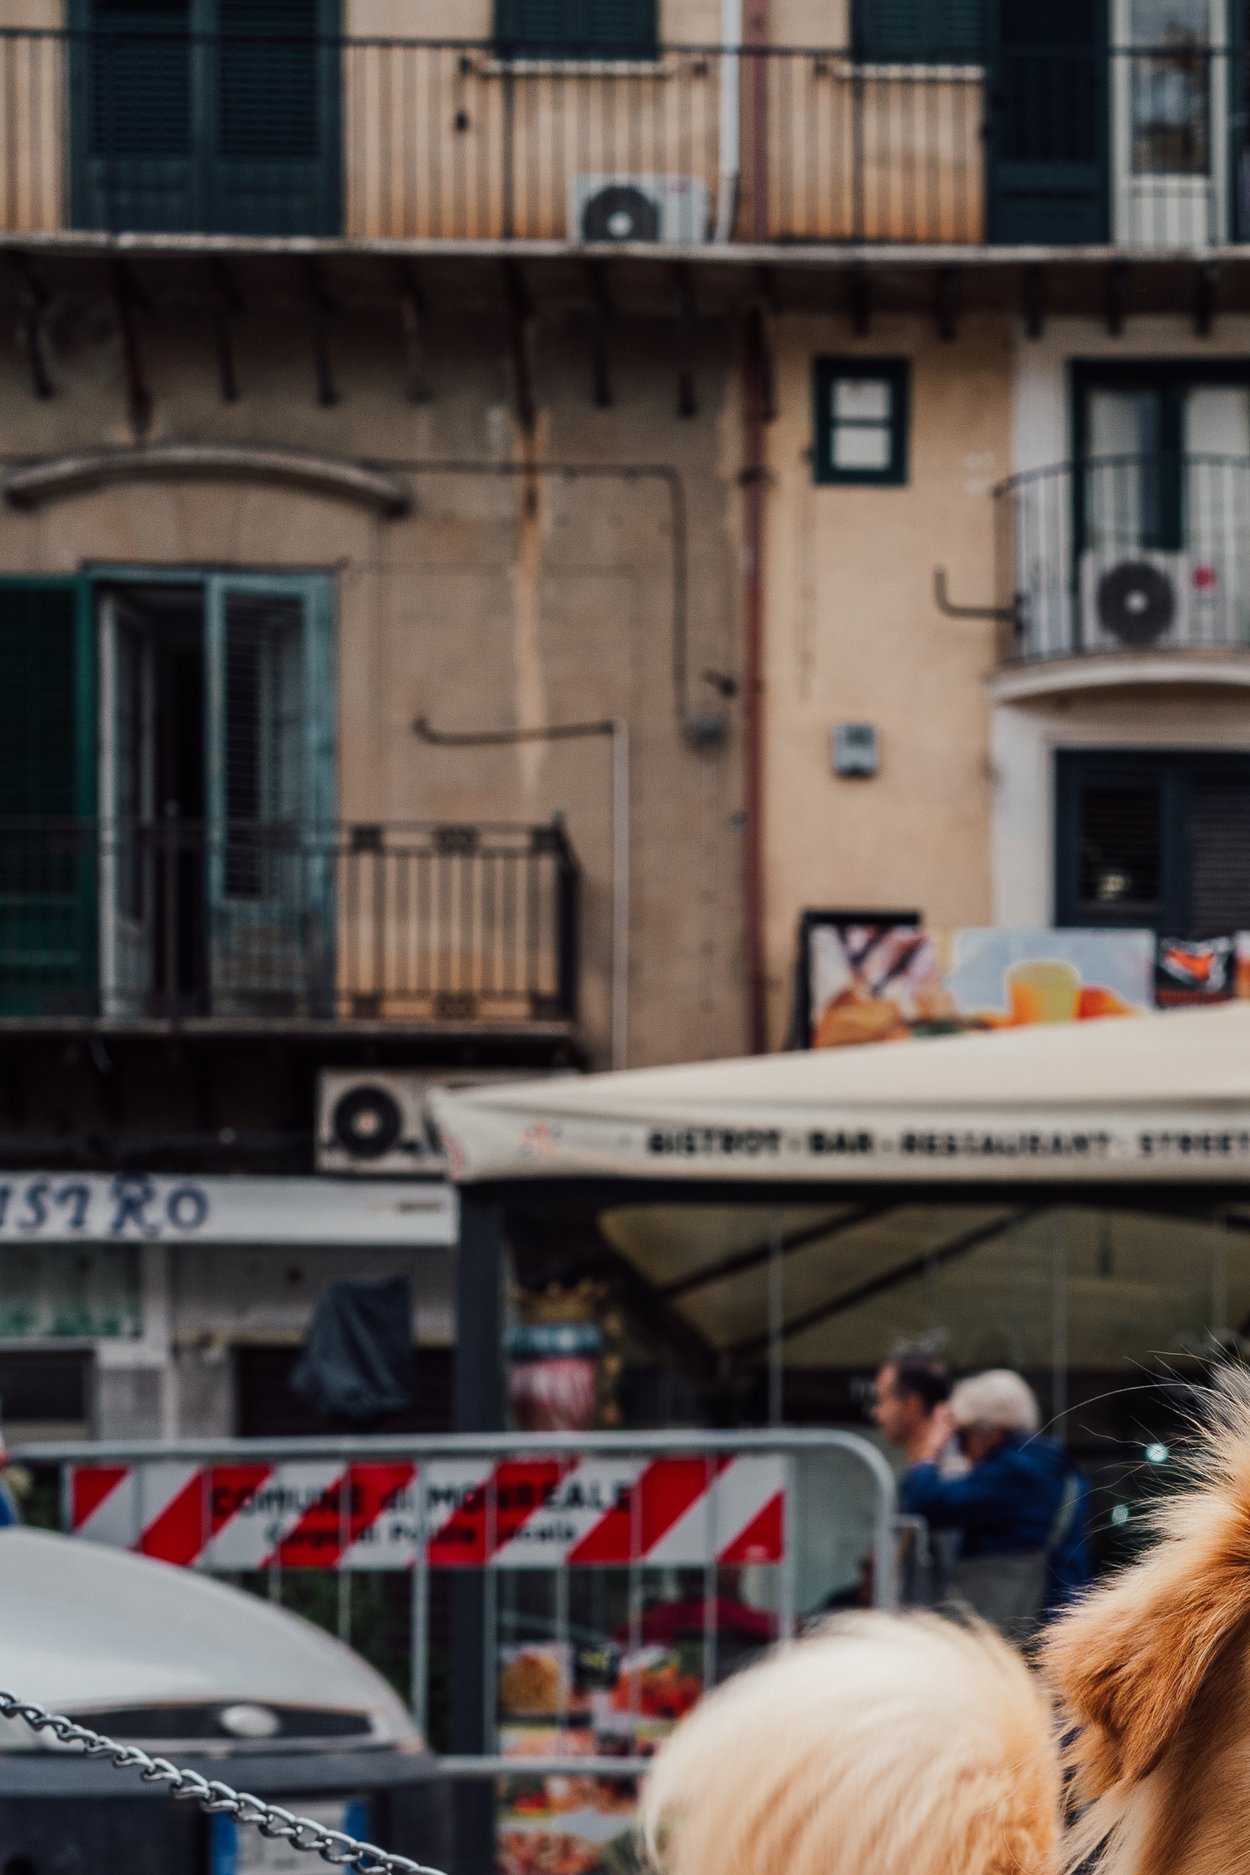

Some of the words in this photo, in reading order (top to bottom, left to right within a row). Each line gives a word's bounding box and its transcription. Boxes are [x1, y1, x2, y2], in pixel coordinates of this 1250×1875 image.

[648, 1127, 783, 1157] BISTROT
[807, 1128, 874, 1157] BAR
[210, 1484, 364, 1516] COMUNE
[427, 1481, 634, 1513] MONREALE
